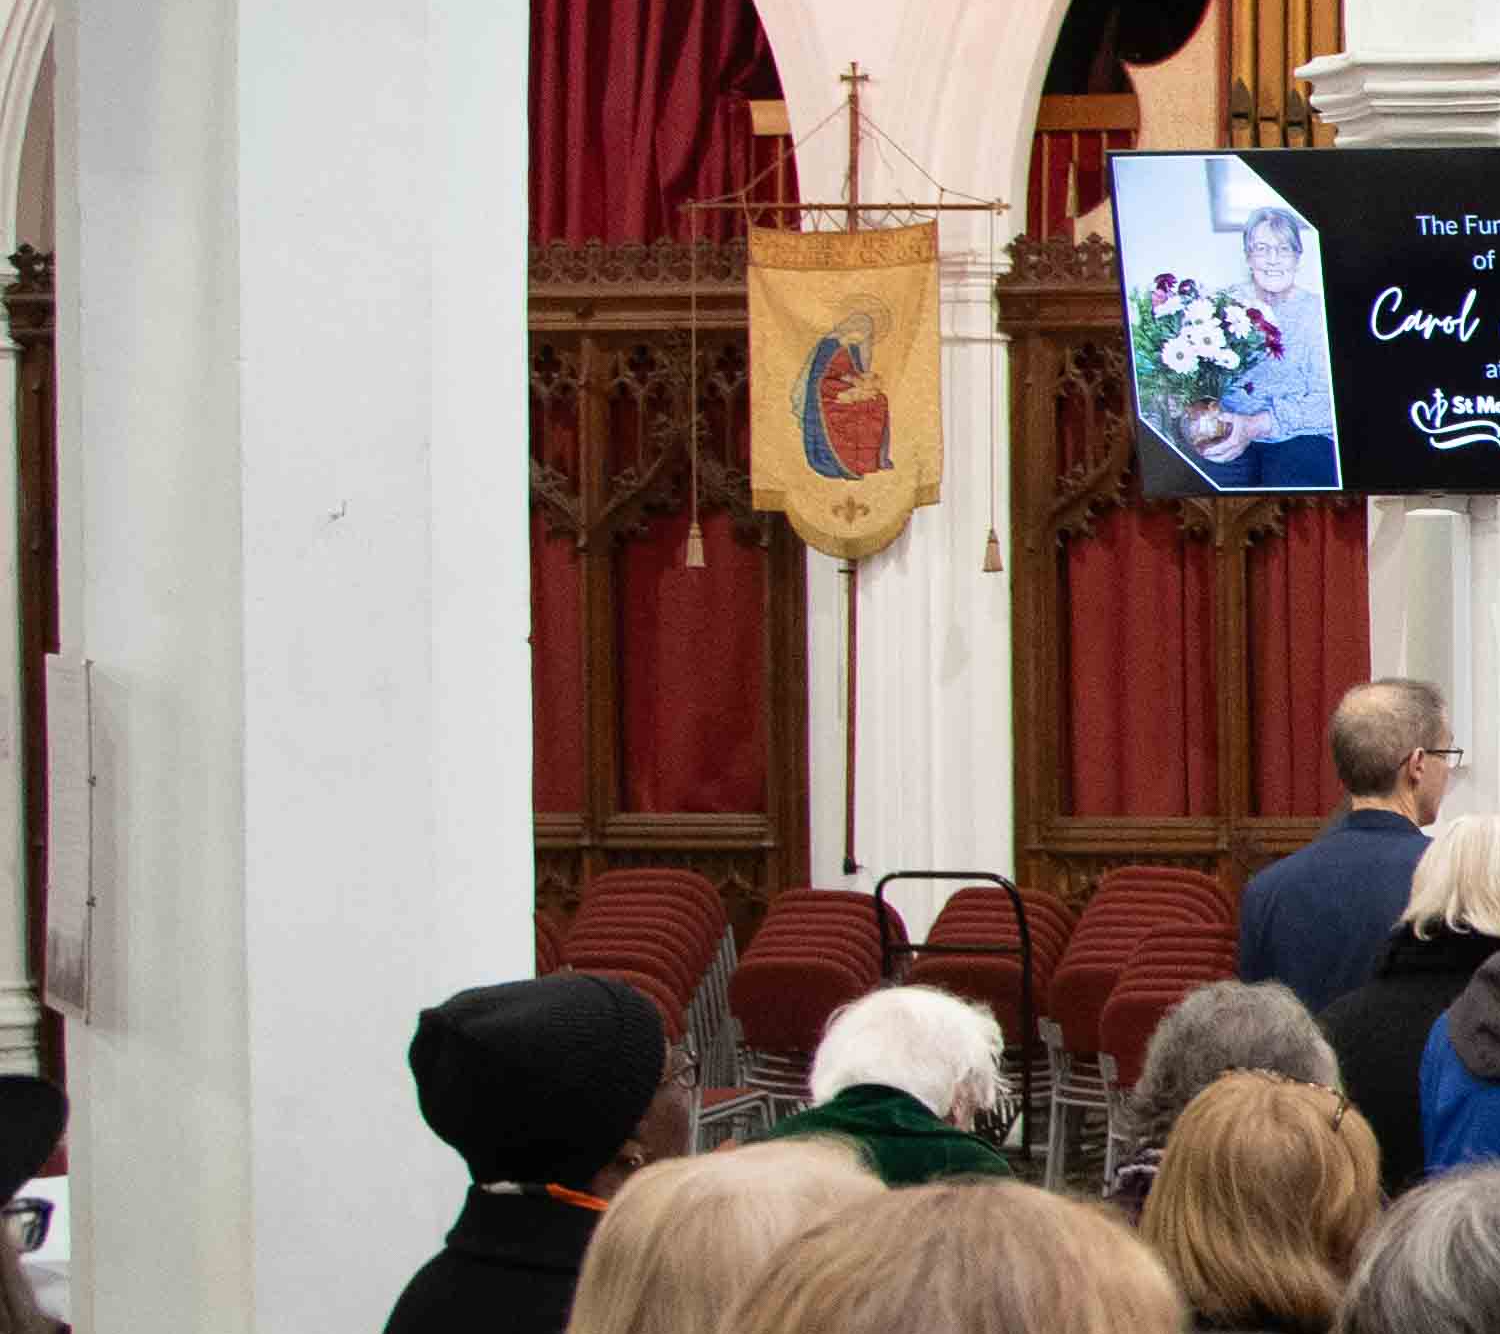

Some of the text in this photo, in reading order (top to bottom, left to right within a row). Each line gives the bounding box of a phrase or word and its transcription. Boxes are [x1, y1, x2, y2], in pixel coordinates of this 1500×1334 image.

[1415, 213, 1459, 236] The
[1472, 249, 1496, 270] of
[1370, 285, 1481, 343] Carol
[1451, 396, 1475, 416] St
